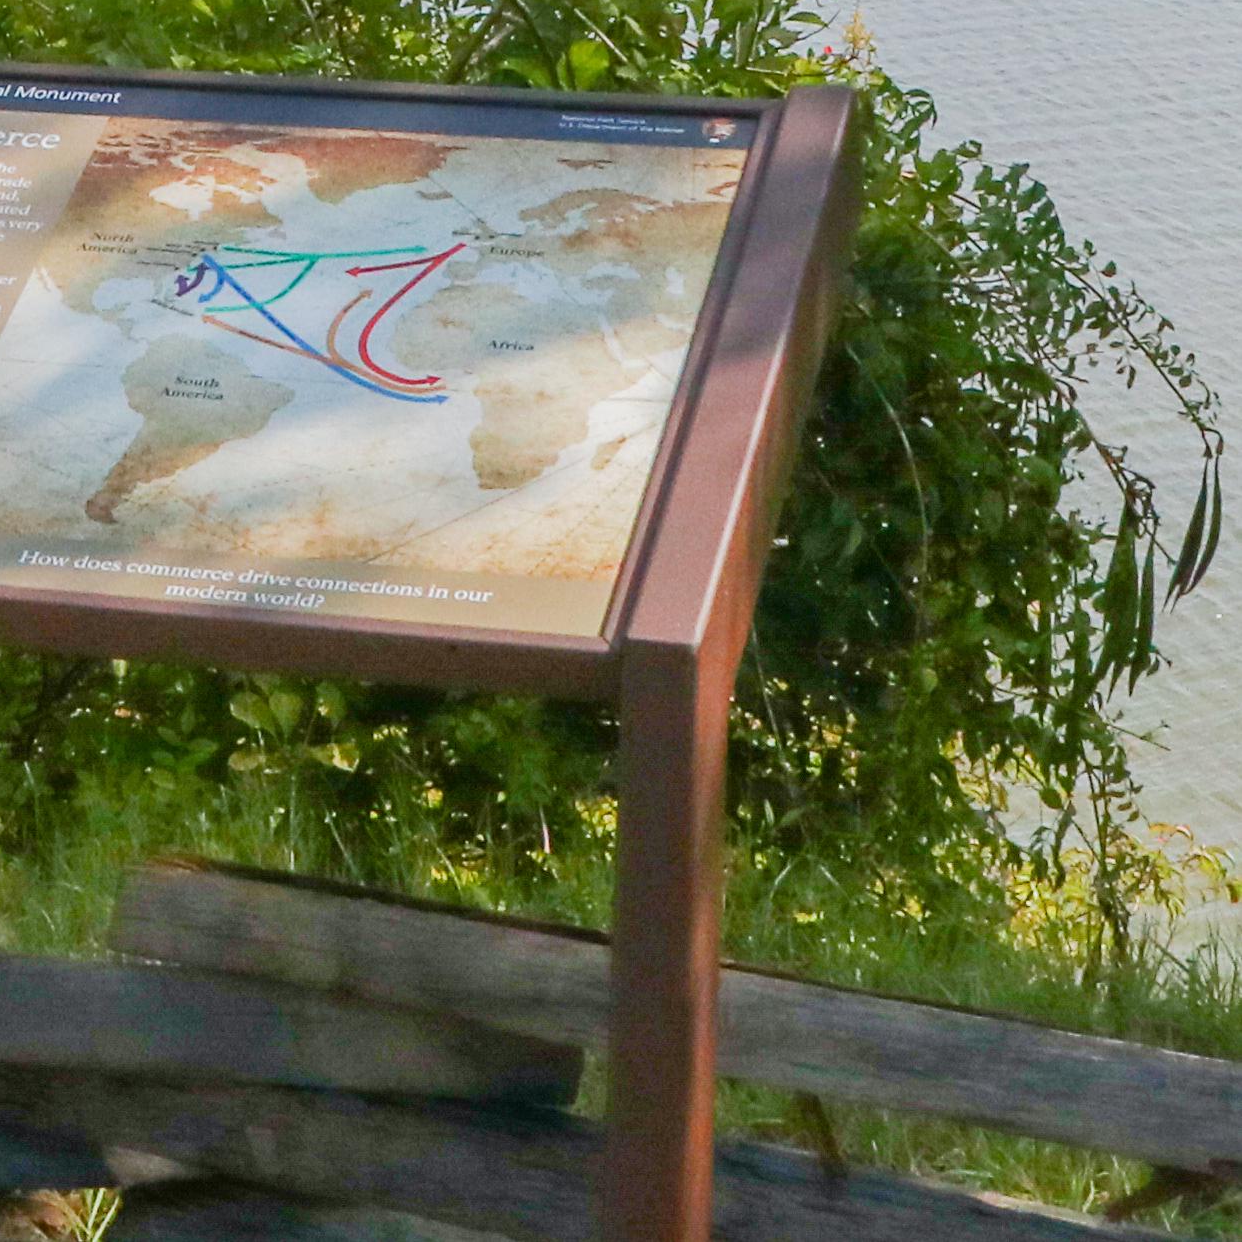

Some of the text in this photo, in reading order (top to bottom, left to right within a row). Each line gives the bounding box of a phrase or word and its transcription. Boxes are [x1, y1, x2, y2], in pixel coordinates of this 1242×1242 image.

[13, 85, 122, 104] Monument
[91, 231, 135, 242] North
[76, 242, 138, 254] America
[488, 246, 545, 258] Europe
[487, 340, 535, 351] Africa
[174, 376, 220, 388] South
[161, 387, 224, 400] America
[18, 549, 494, 603] How does commerce drive connections in our
[165, 583, 326, 608] modern world?
